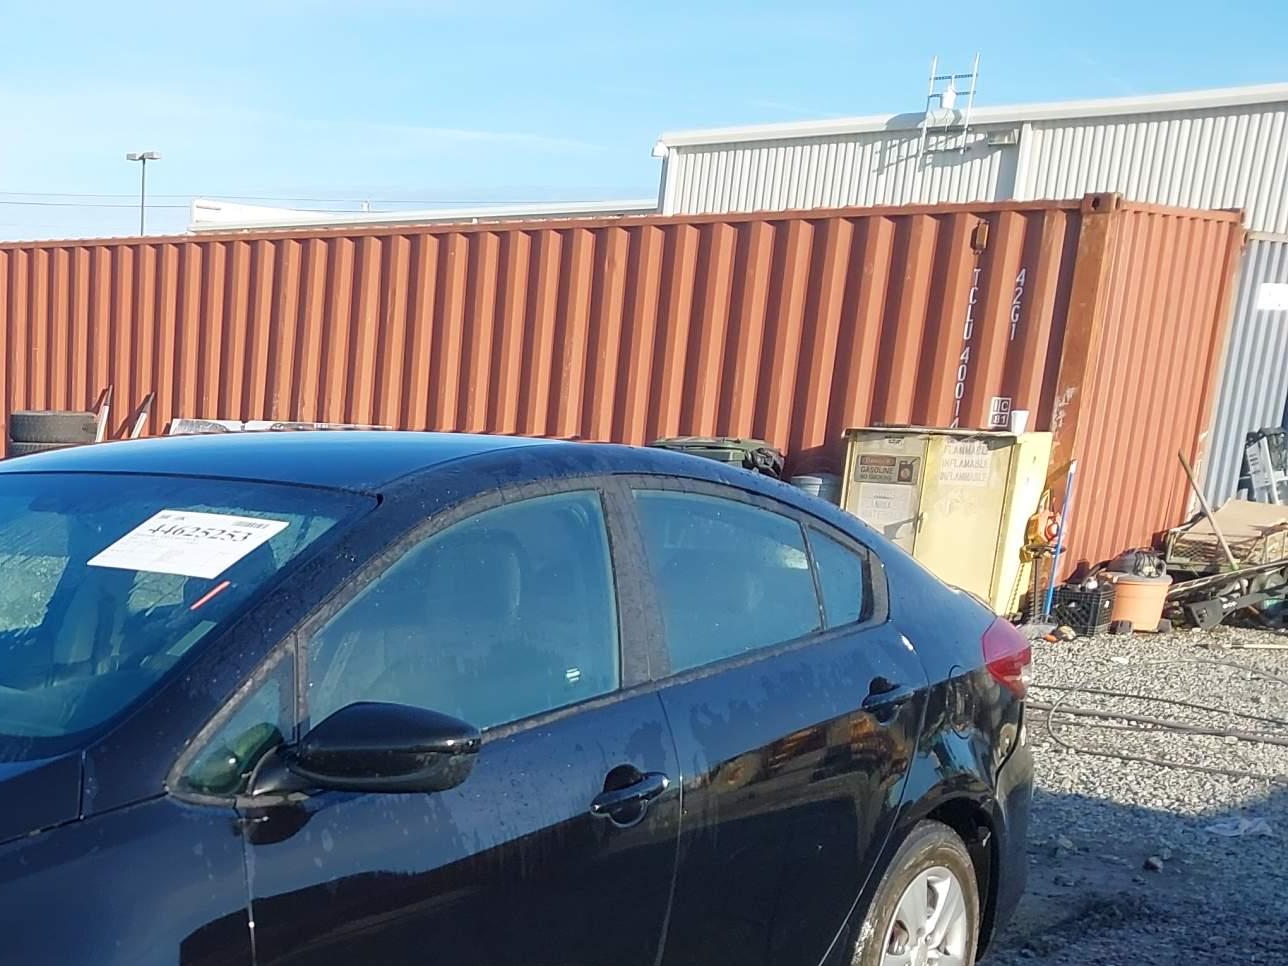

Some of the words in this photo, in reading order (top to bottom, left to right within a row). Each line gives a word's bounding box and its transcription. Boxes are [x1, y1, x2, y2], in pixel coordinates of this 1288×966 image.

[1010, 268, 1026, 341] 42G1
[860, 465, 895, 475] GASOLINE
[149, 523, 252, 541] 44625253
